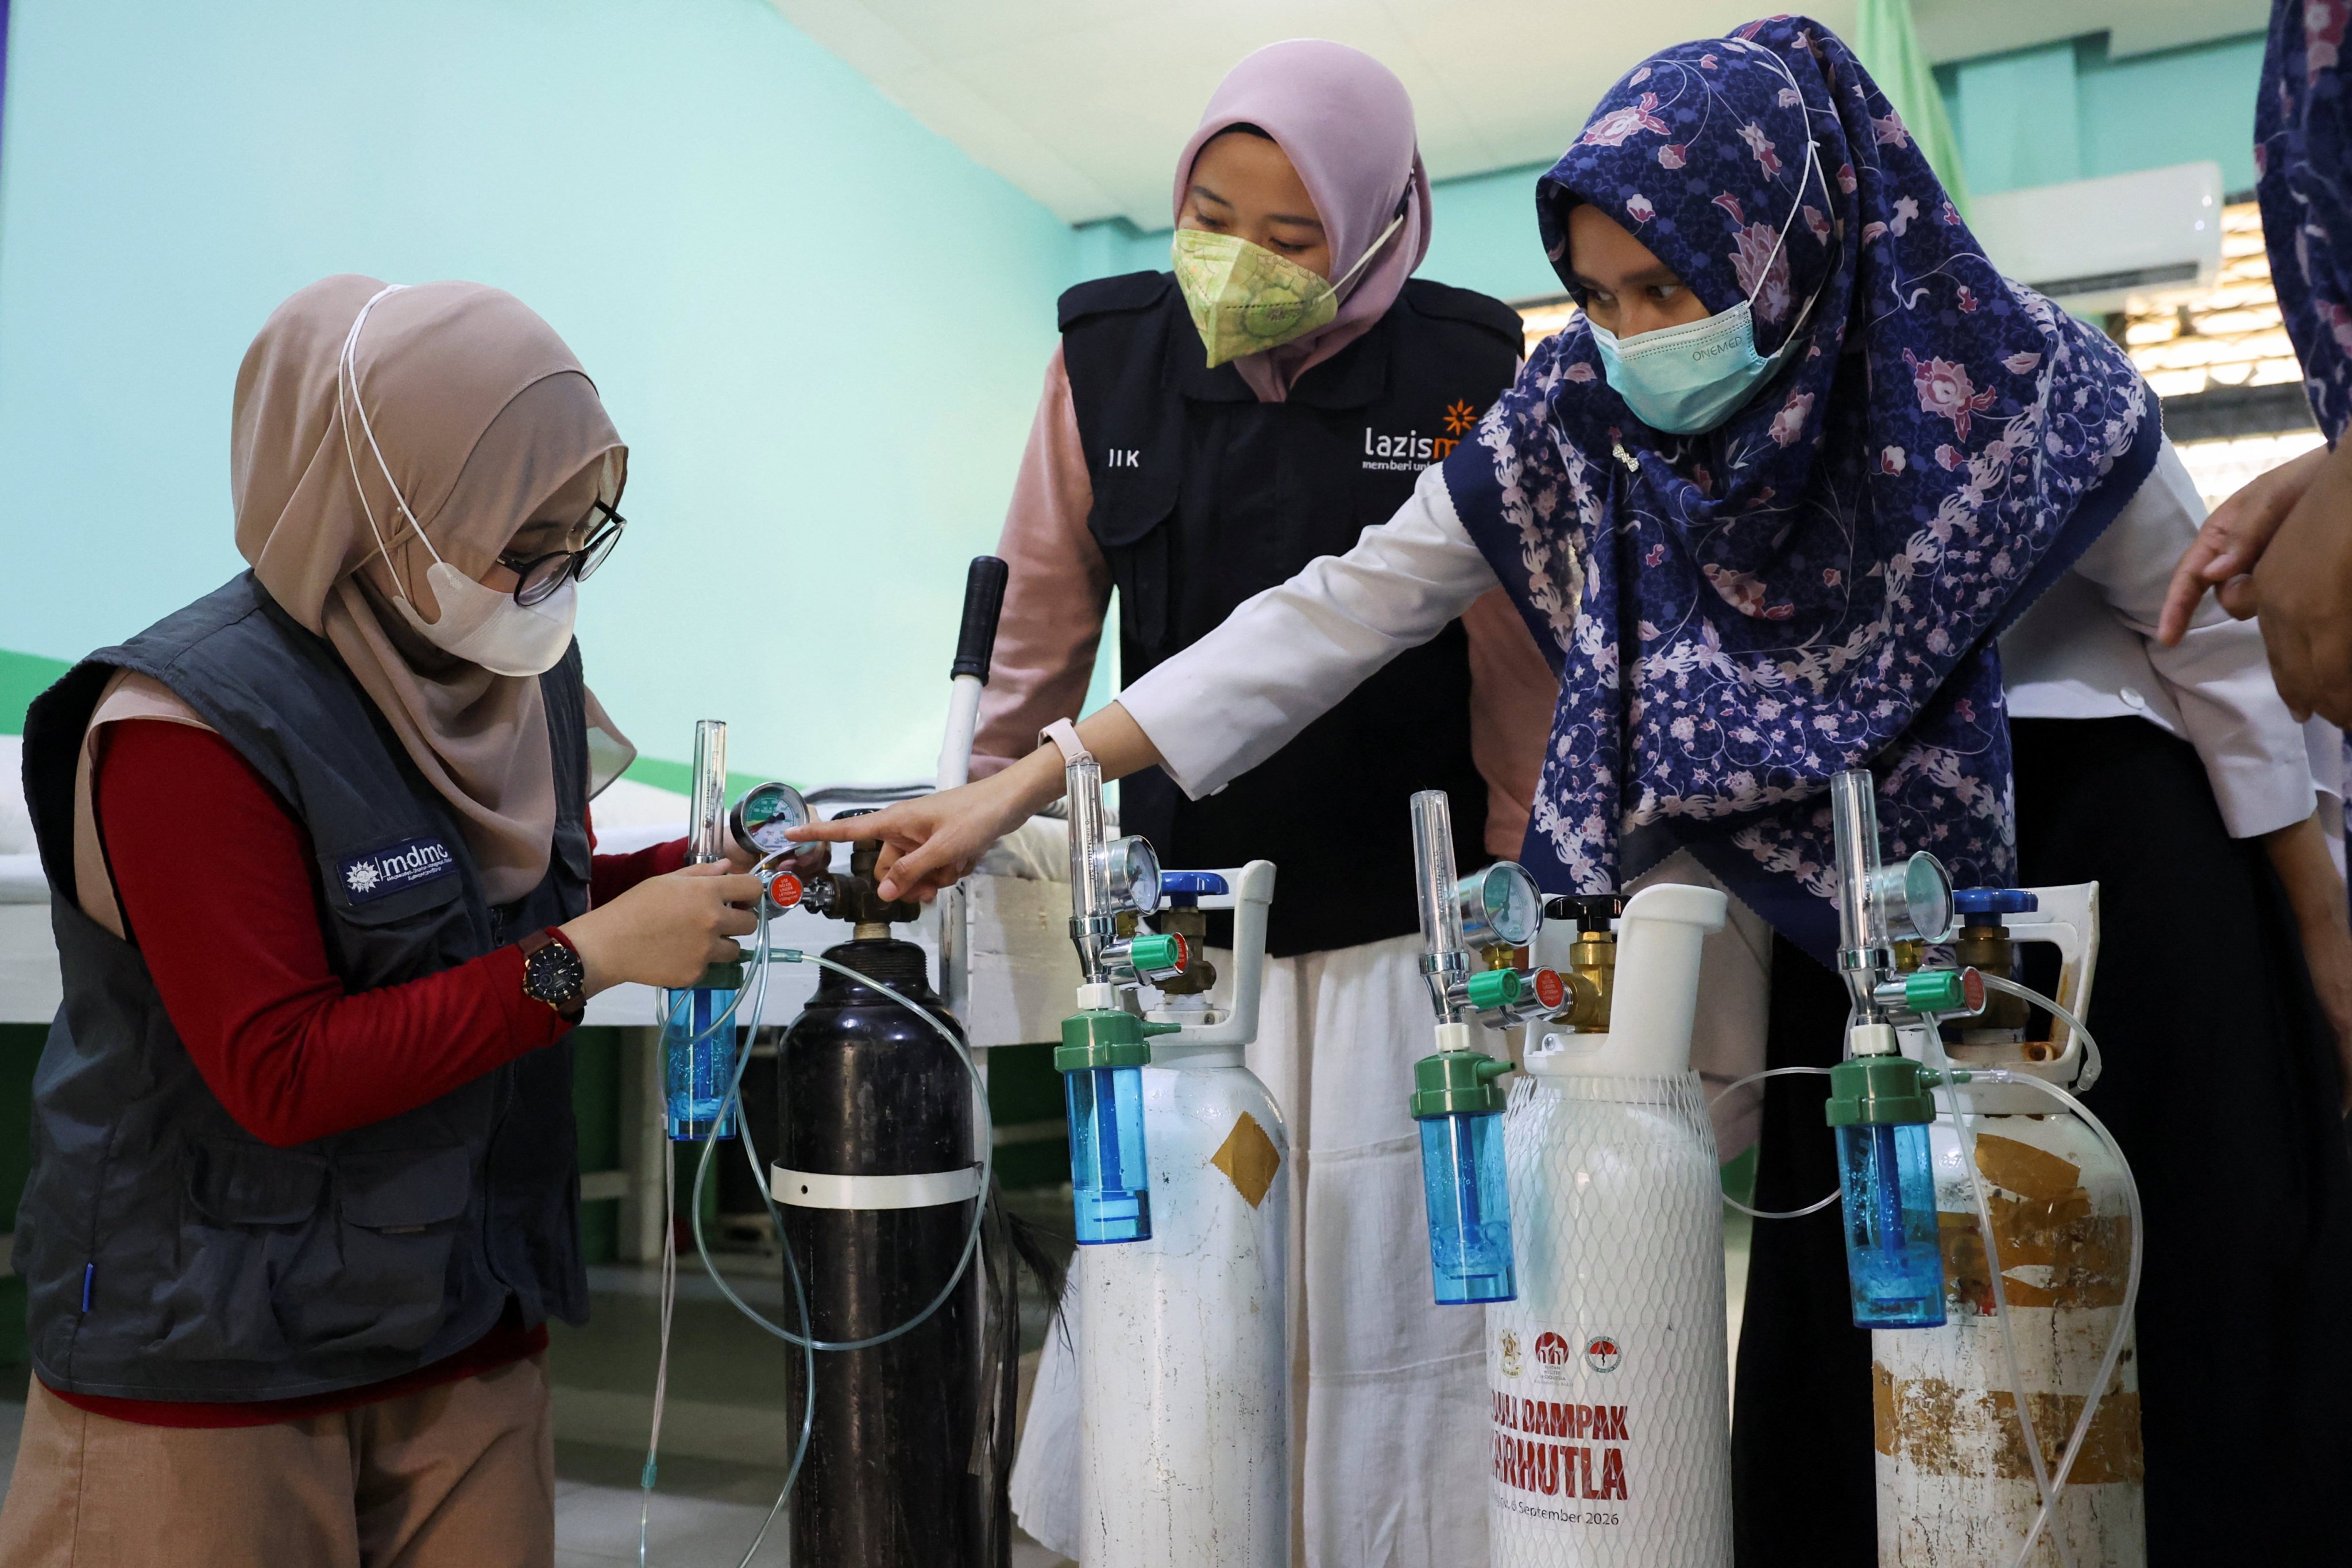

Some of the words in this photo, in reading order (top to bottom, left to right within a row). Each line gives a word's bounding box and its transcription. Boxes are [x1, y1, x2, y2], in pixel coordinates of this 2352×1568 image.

[1693, 337, 1742, 361] ONEMED
[1362, 459, 1412, 470] memberi
[382, 844, 448, 876] mdmc
[1522, 1398, 1629, 1440] DAMPAK
[1519, 1501, 1581, 1524] September
